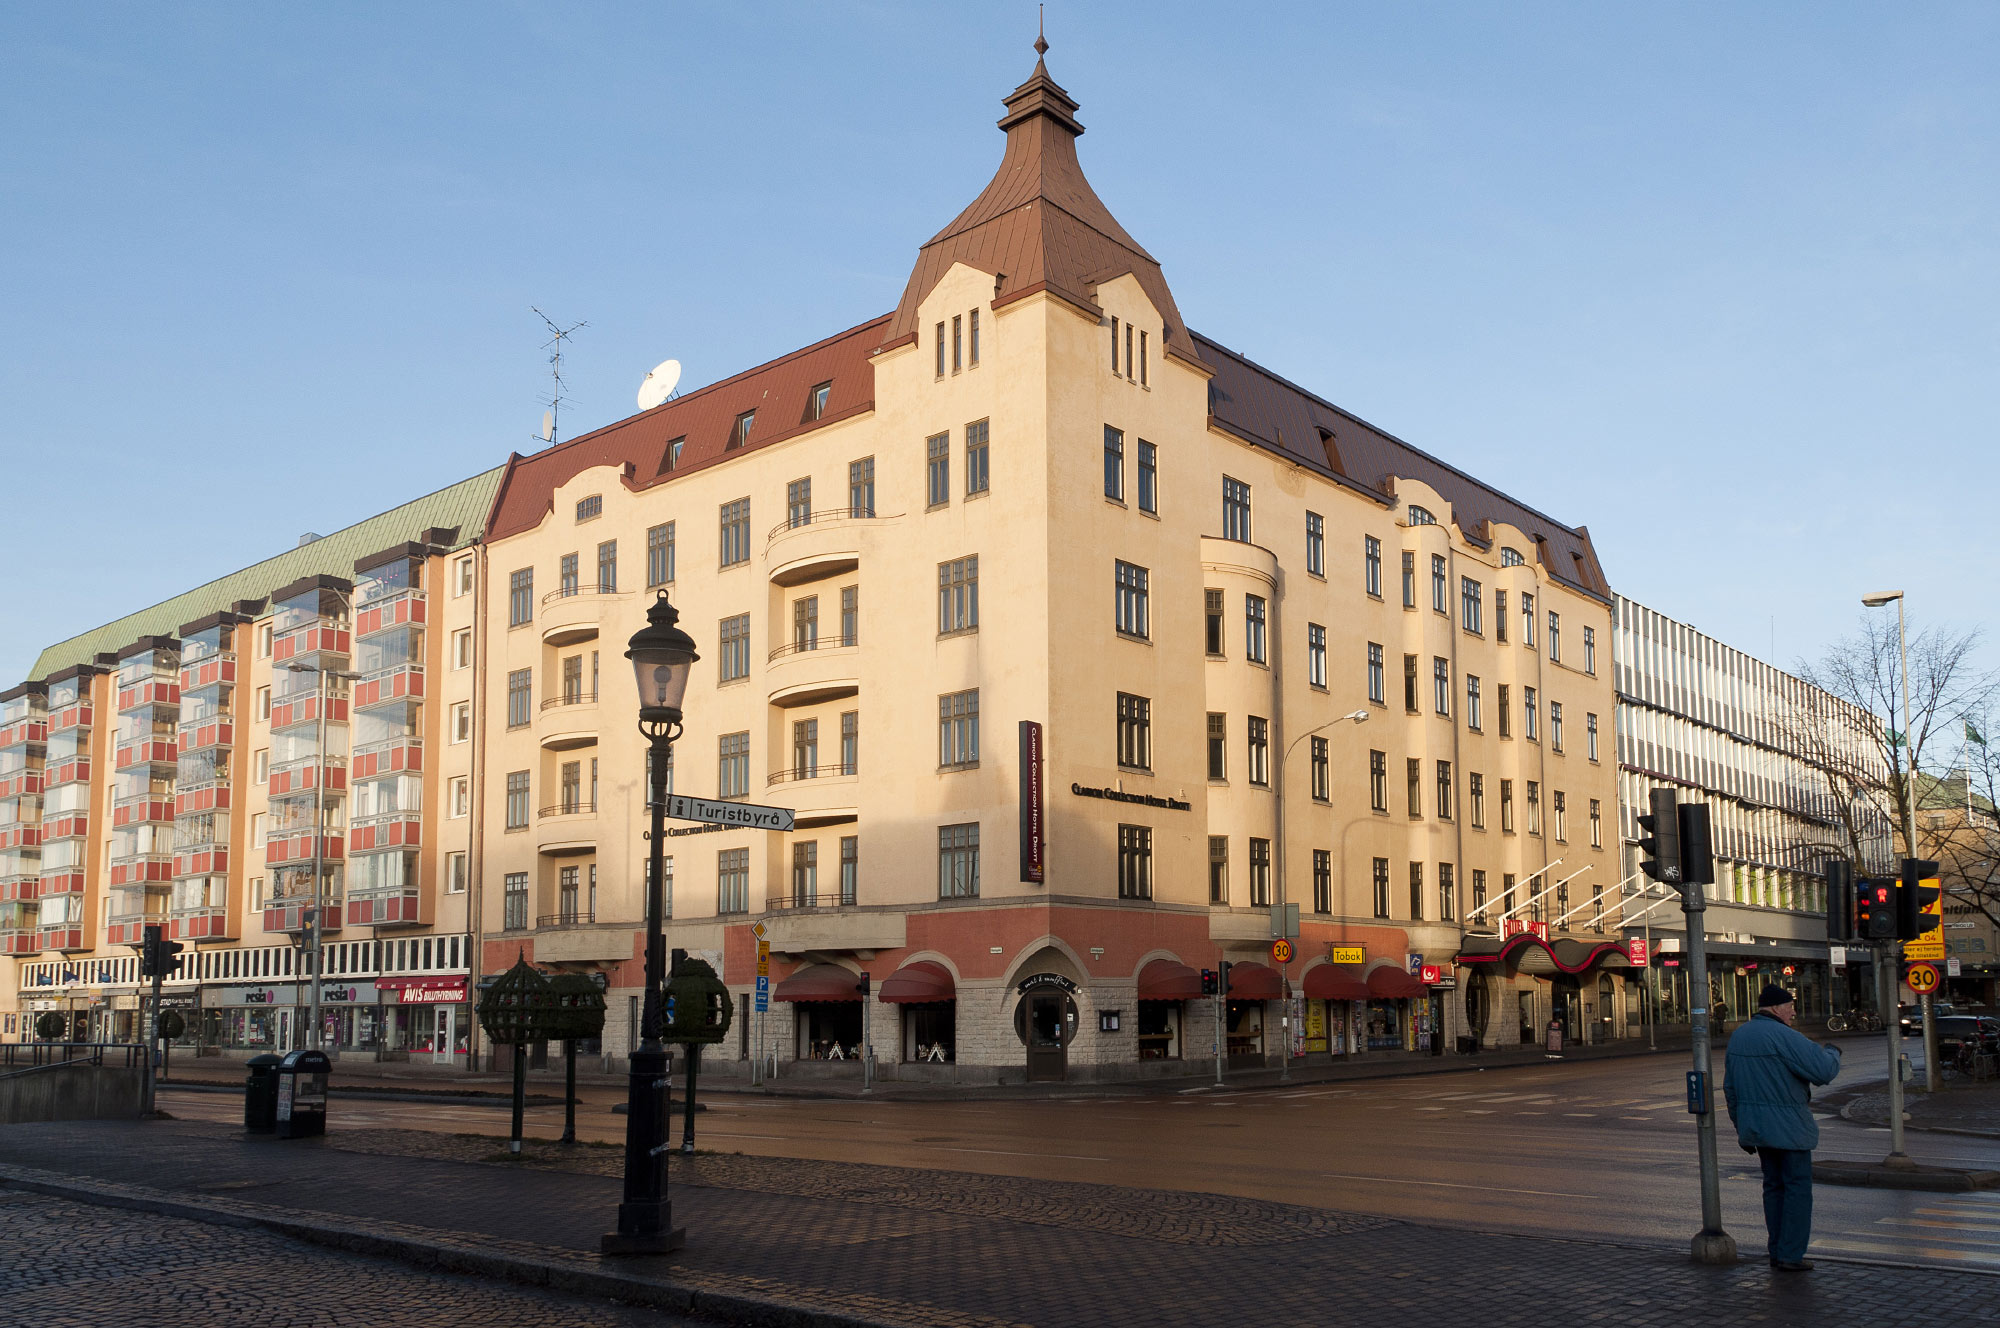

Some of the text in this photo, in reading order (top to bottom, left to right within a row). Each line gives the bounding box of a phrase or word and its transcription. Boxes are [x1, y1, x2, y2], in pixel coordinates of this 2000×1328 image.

[696, 803, 780, 826] Turistbyrå
[703, 823, 724, 834] HOTEL
[1503, 918, 1524, 942] HOTEL
[1275, 945, 1289, 957] 30
[1335, 951, 1361, 961] Tobak
[759, 977, 767, 990] P
[1911, 970, 1934, 986] 30
[245, 987, 267, 1003] resia
[324, 984, 348, 1002] resia
[403, 987, 464, 1002] AVIS BILUTHYRNING
